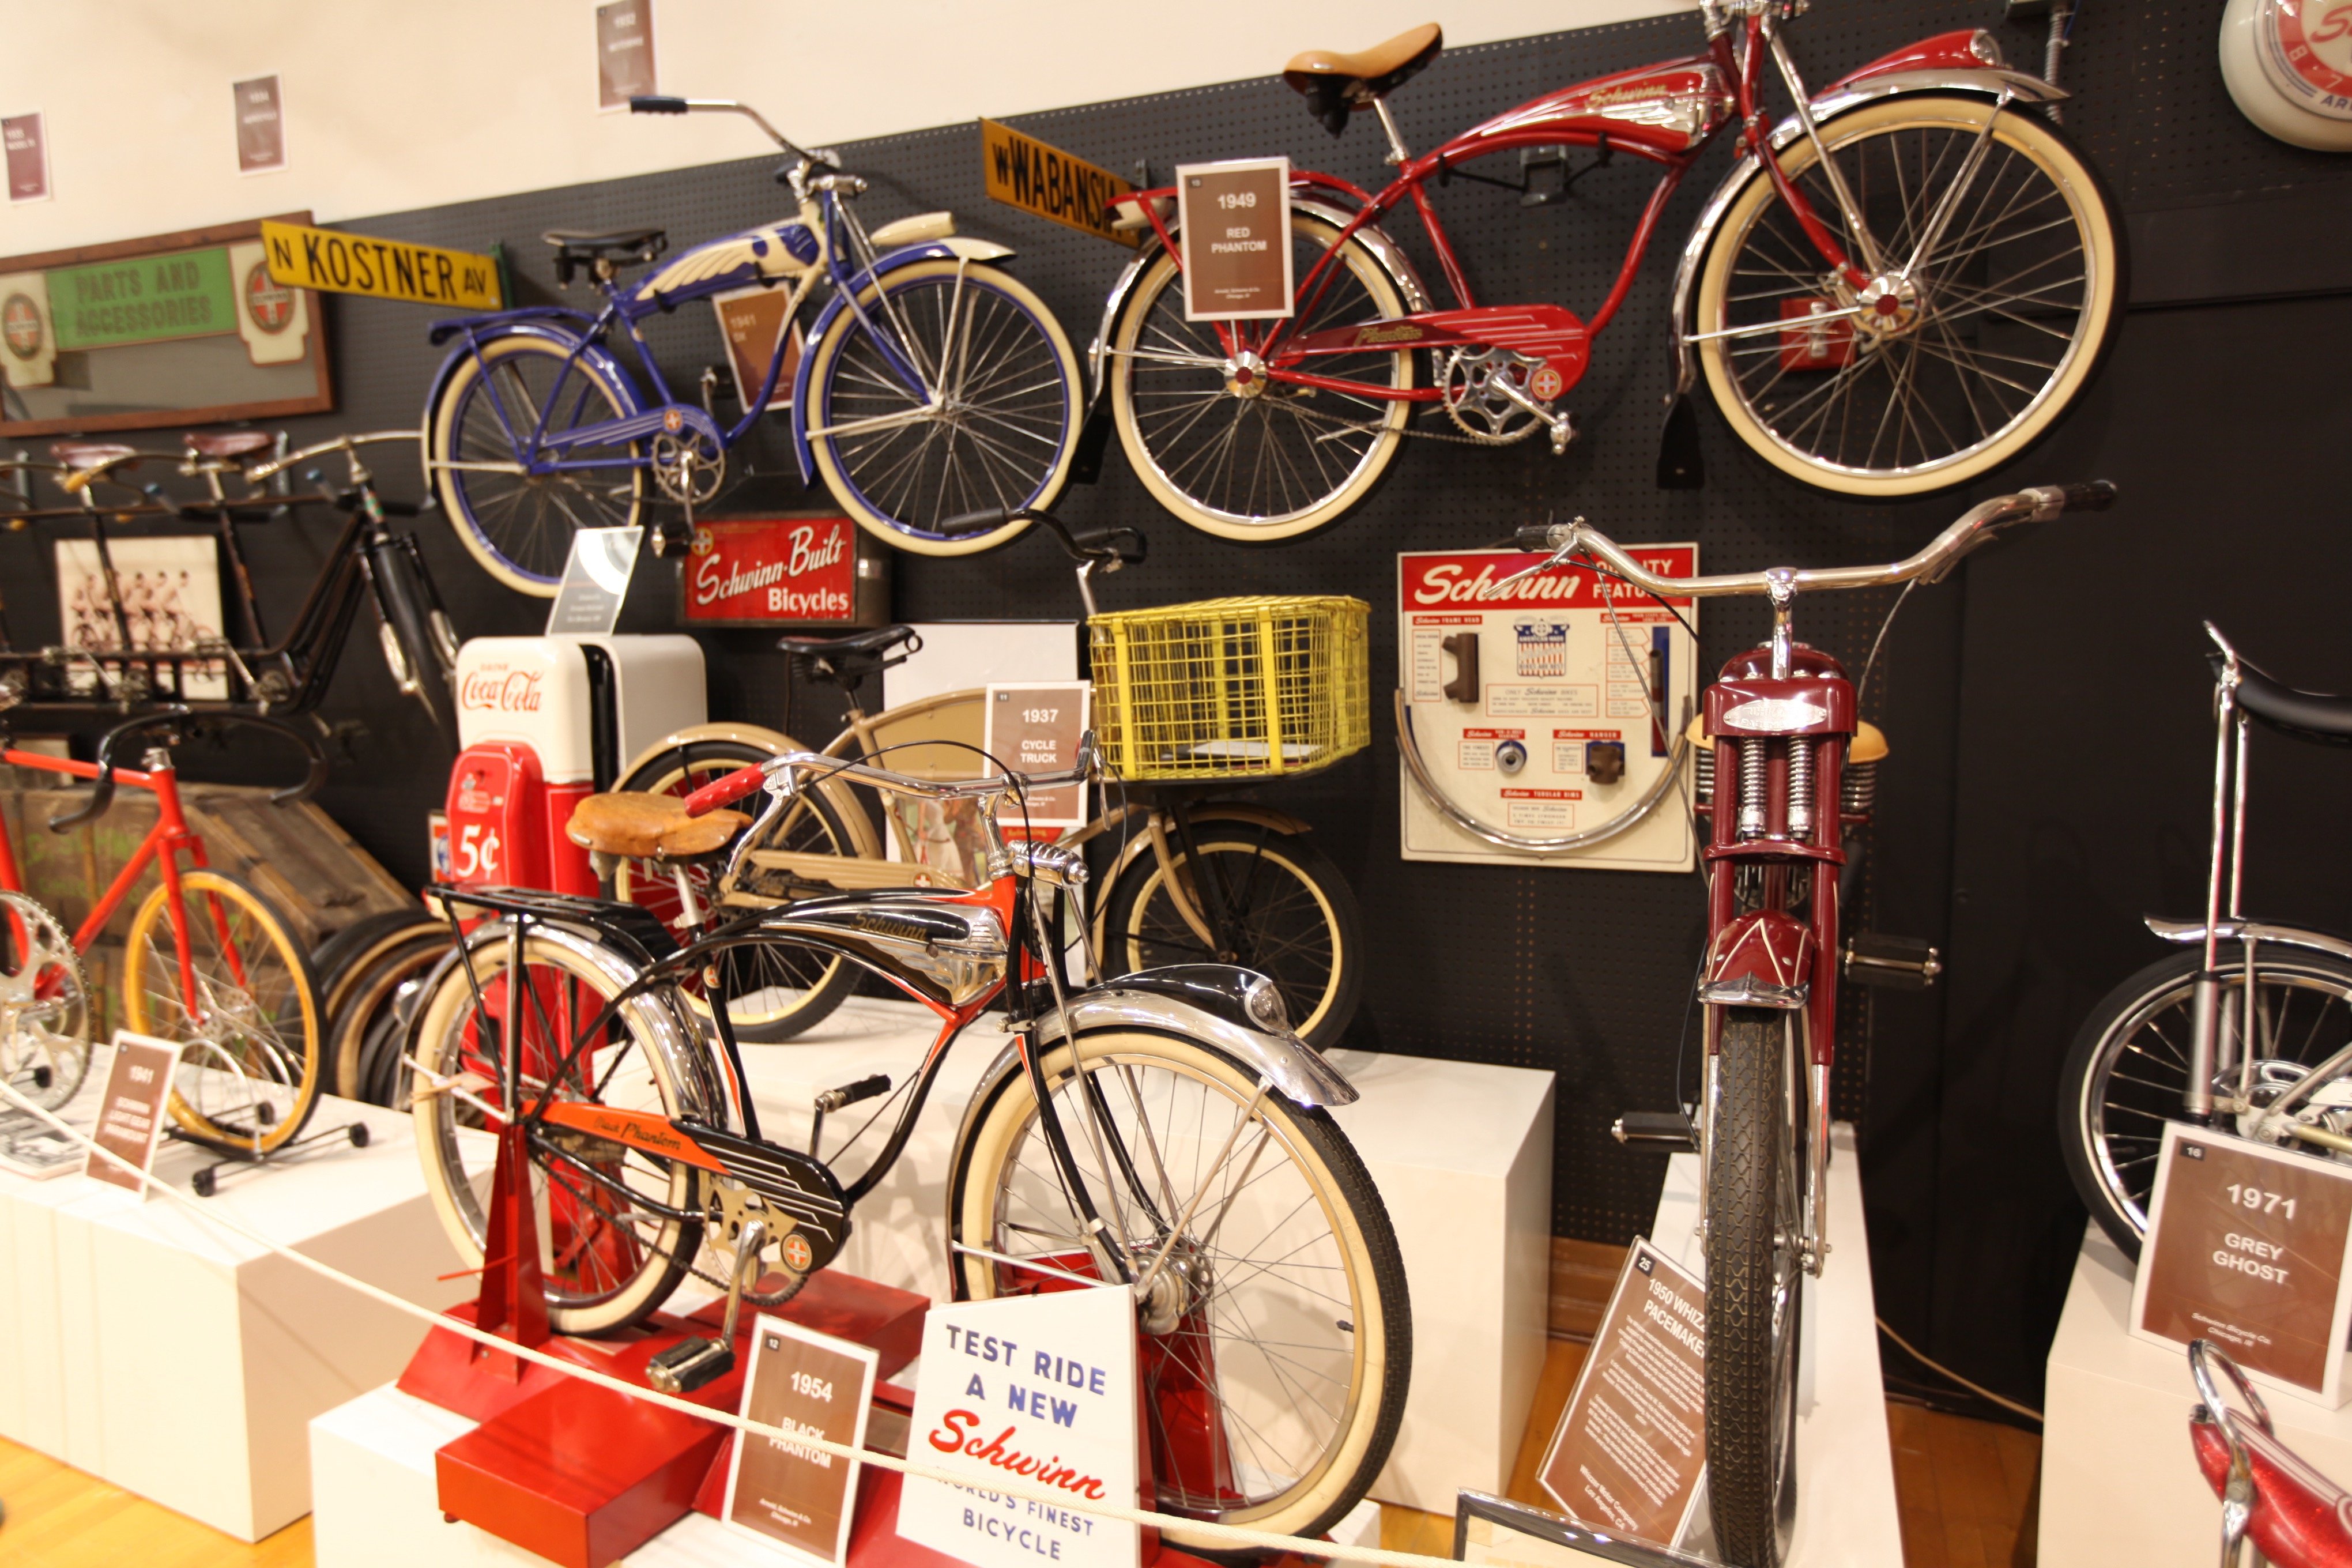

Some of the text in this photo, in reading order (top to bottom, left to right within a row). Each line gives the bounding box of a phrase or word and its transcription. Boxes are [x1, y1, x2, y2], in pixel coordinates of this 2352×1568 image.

[993, 144, 1008, 186] W
[1218, 192, 1256, 210] 1949
[1211, 240, 1268, 254] PHANTOM
[1226, 227, 1251, 239] RED
[76, 261, 201, 304] PARTS AND
[273, 233, 487, 300] N KOSTNER AV
[76, 295, 213, 338] ACCESSORIES
[696, 523, 847, 605] Schwinn-Built
[768, 587, 849, 615] Bicycles
[1414, 564, 1581, 605] Schwinn
[462, 670, 544, 711] Coca-Cola
[1022, 709, 1058, 723] 1937
[1020, 752, 1057, 764] TRUCK
[1021, 740, 1057, 750] CYCLE
[456, 824, 500, 880] 5¢
[850, 910, 927, 941] Schwinn
[620, 1121, 682, 1151] Phantom
[2227, 1183, 2297, 1220] 1971
[2224, 1232, 2284, 1261] GREY
[1638, 1257, 1652, 1272] 25
[2212, 1250, 2290, 1284] GHOST
[1649, 1277, 1674, 1305] 1950
[768, 1338, 779, 1350] 12
[2226, 1323, 2256, 1340] Bicycle
[946, 1323, 1106, 1396] TEST RIDE
[790, 1371, 834, 1403] 1954
[965, 1373, 1078, 1428] A NEW
[782, 1416, 826, 1441] BLACK
[928, 1409, 1106, 1500] Schwinn
[1580, 1464, 1600, 1488] Whizzer
[1599, 1484, 1615, 1504] Motor
[1027, 1500, 1094, 1536] FINEST
[1584, 1484, 1596, 1498] Los
[1615, 1518, 1626, 1531] CA
[963, 1507, 1061, 1561] BICYCLE
